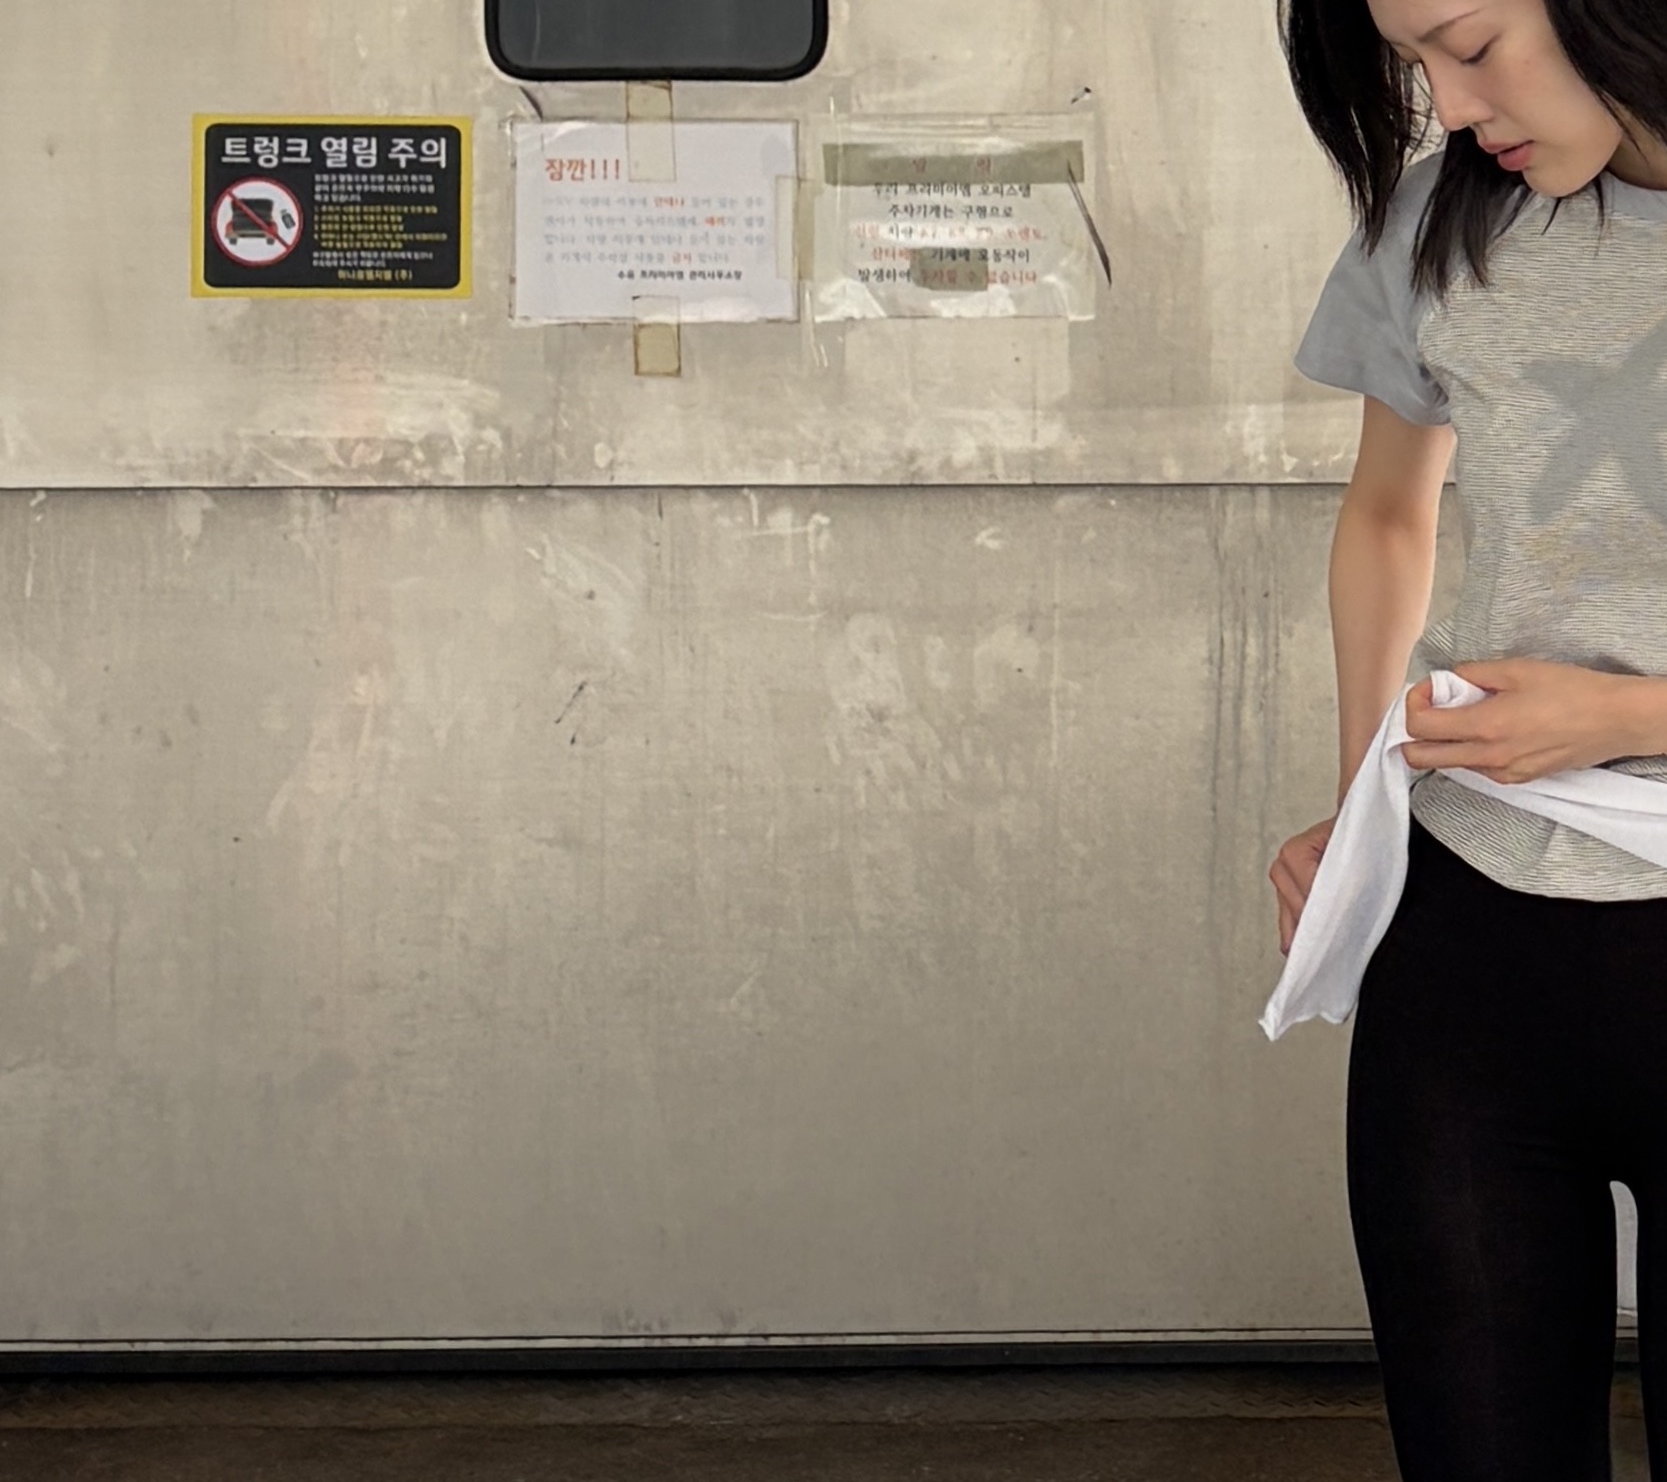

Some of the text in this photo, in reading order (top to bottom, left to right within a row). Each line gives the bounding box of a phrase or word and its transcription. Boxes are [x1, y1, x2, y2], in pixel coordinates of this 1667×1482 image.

[221, 137, 447, 168] 트렁크 열림 주의
[545, 158, 620, 182] 잠깐!!!
